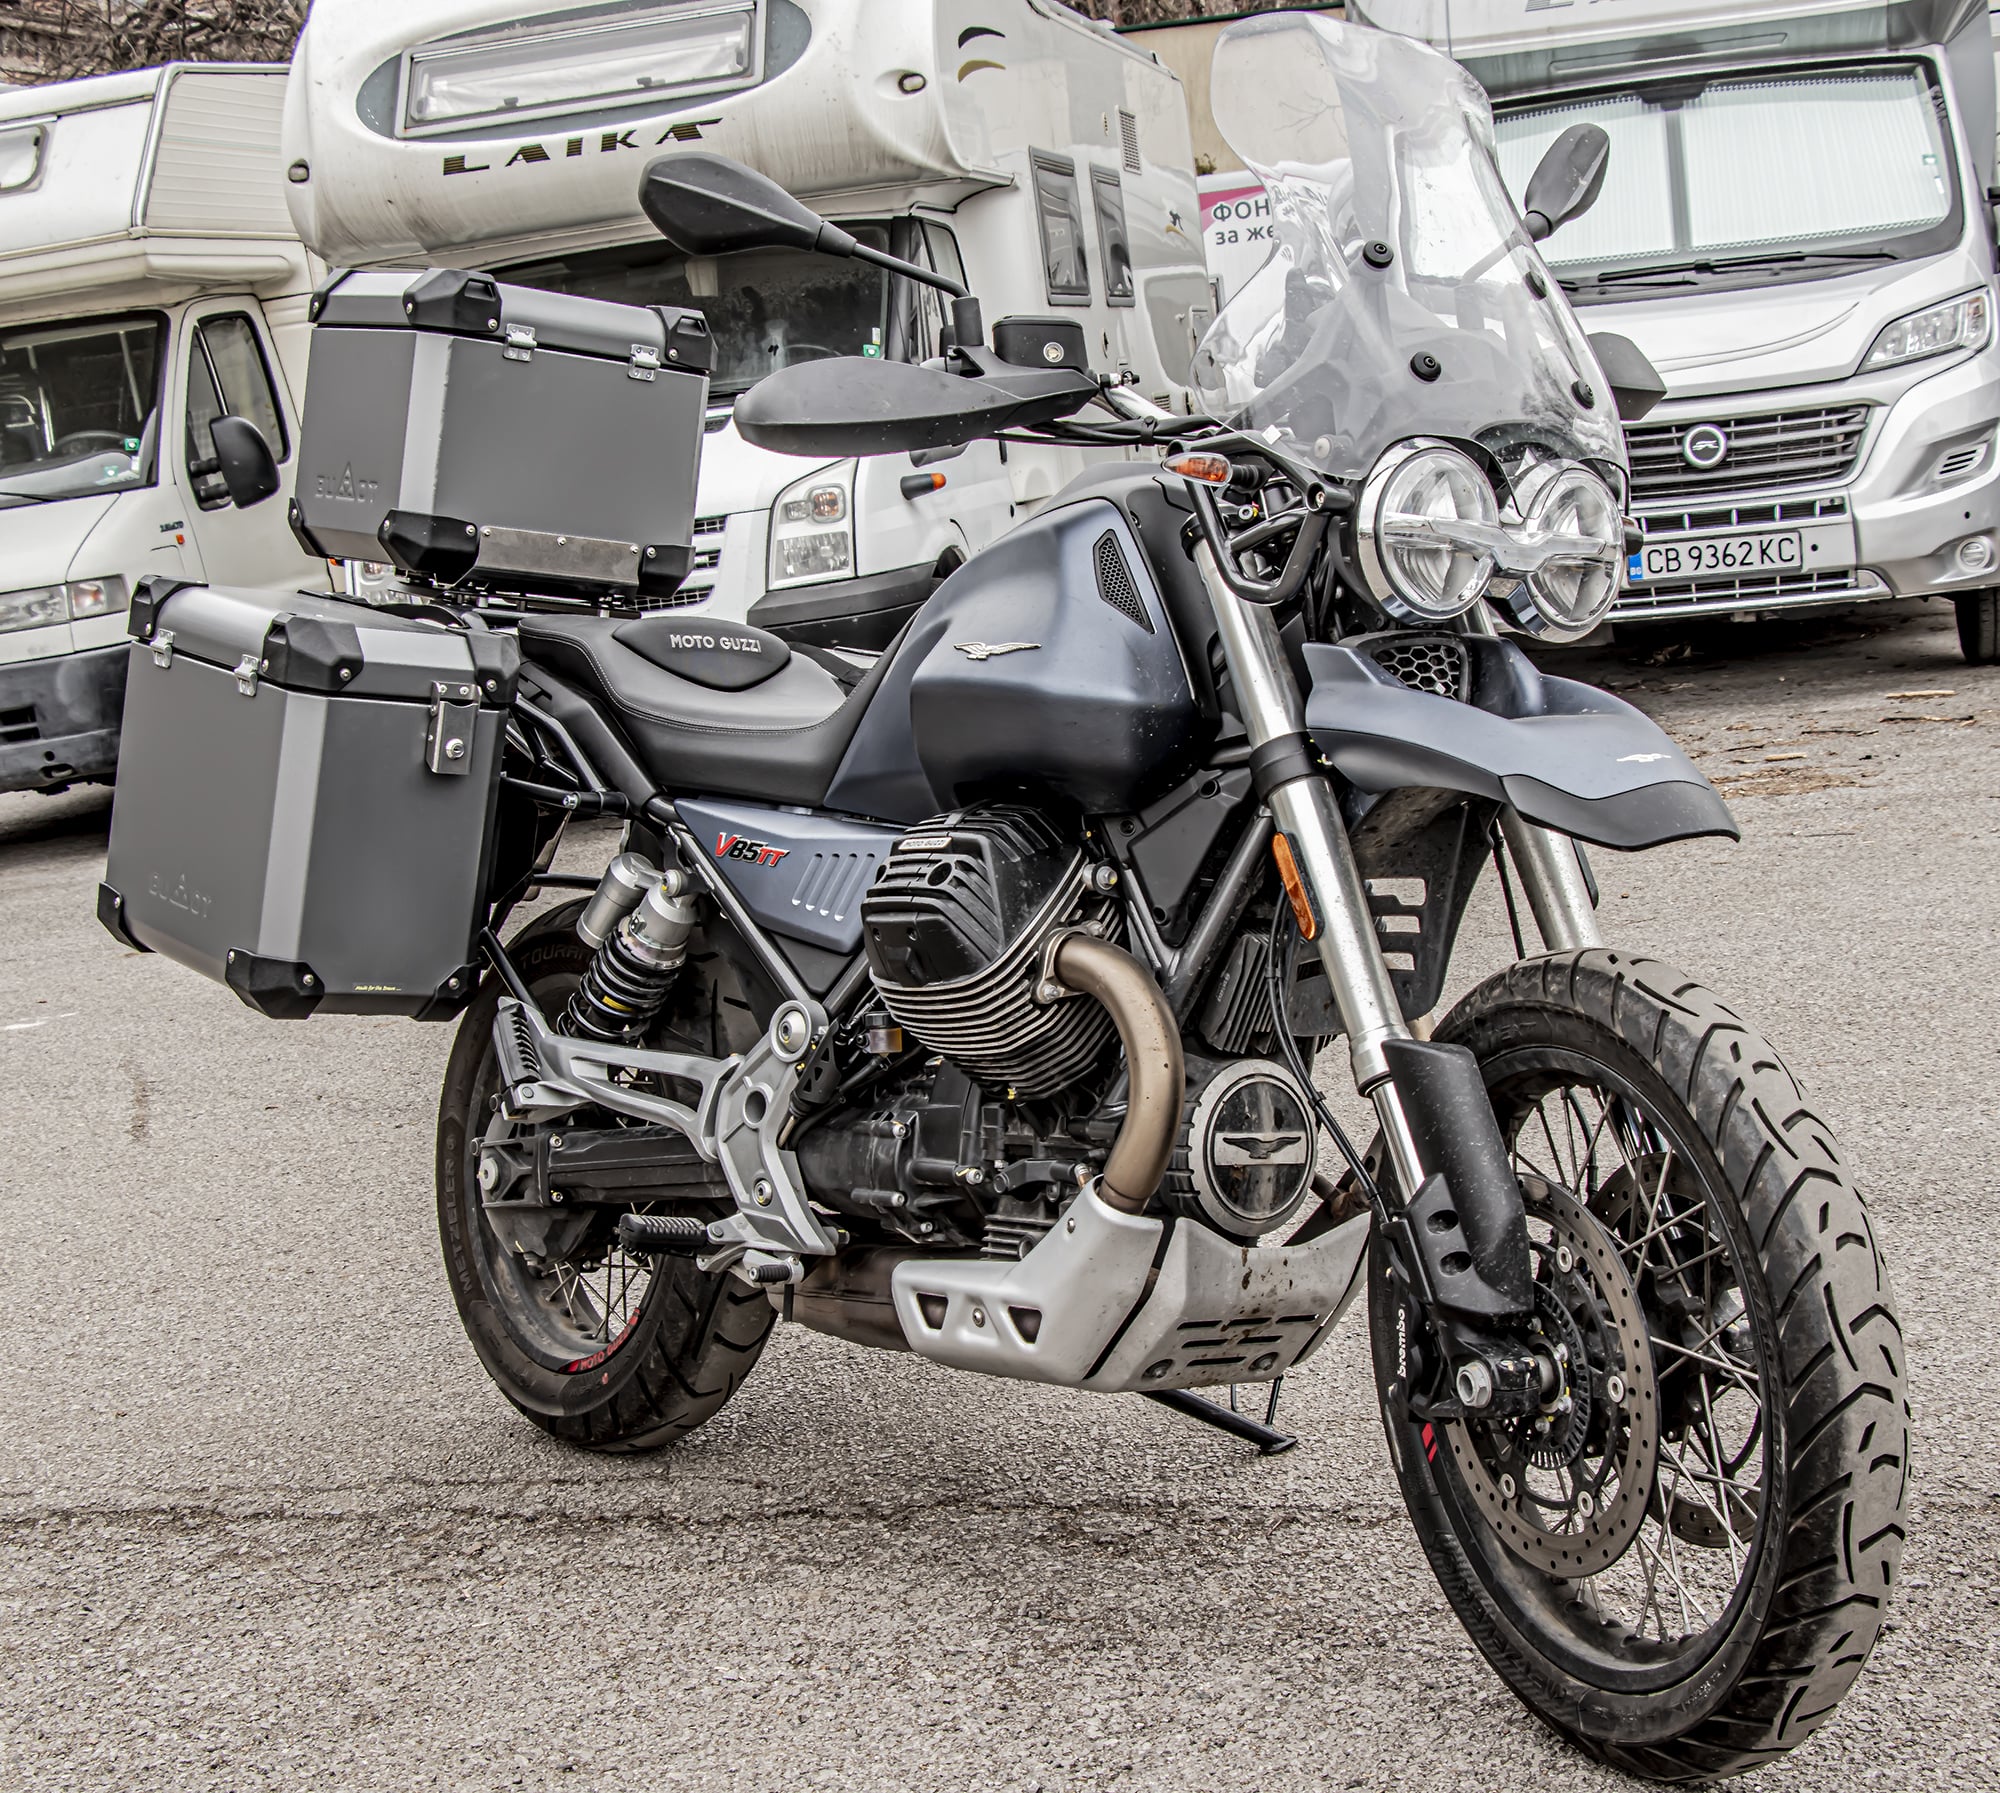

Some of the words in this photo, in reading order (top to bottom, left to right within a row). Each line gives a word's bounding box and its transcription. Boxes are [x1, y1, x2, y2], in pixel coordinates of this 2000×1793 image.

[443, 117, 723, 175] LAIKA
[1215, 230, 1239, 245] за
[1647, 548, 1681, 574] CB
[1688, 541, 1754, 571] 9362
[1759, 538, 1795, 565] KC
[670, 634, 715, 649] MOTO
[719, 637, 762, 653] GUZZI
[715, 832, 790, 867] V85TT
[444, 1158, 473, 1295] METZELER
[1396, 1308, 1407, 1378] brembo
[580, 1351, 605, 1371] MOTO
